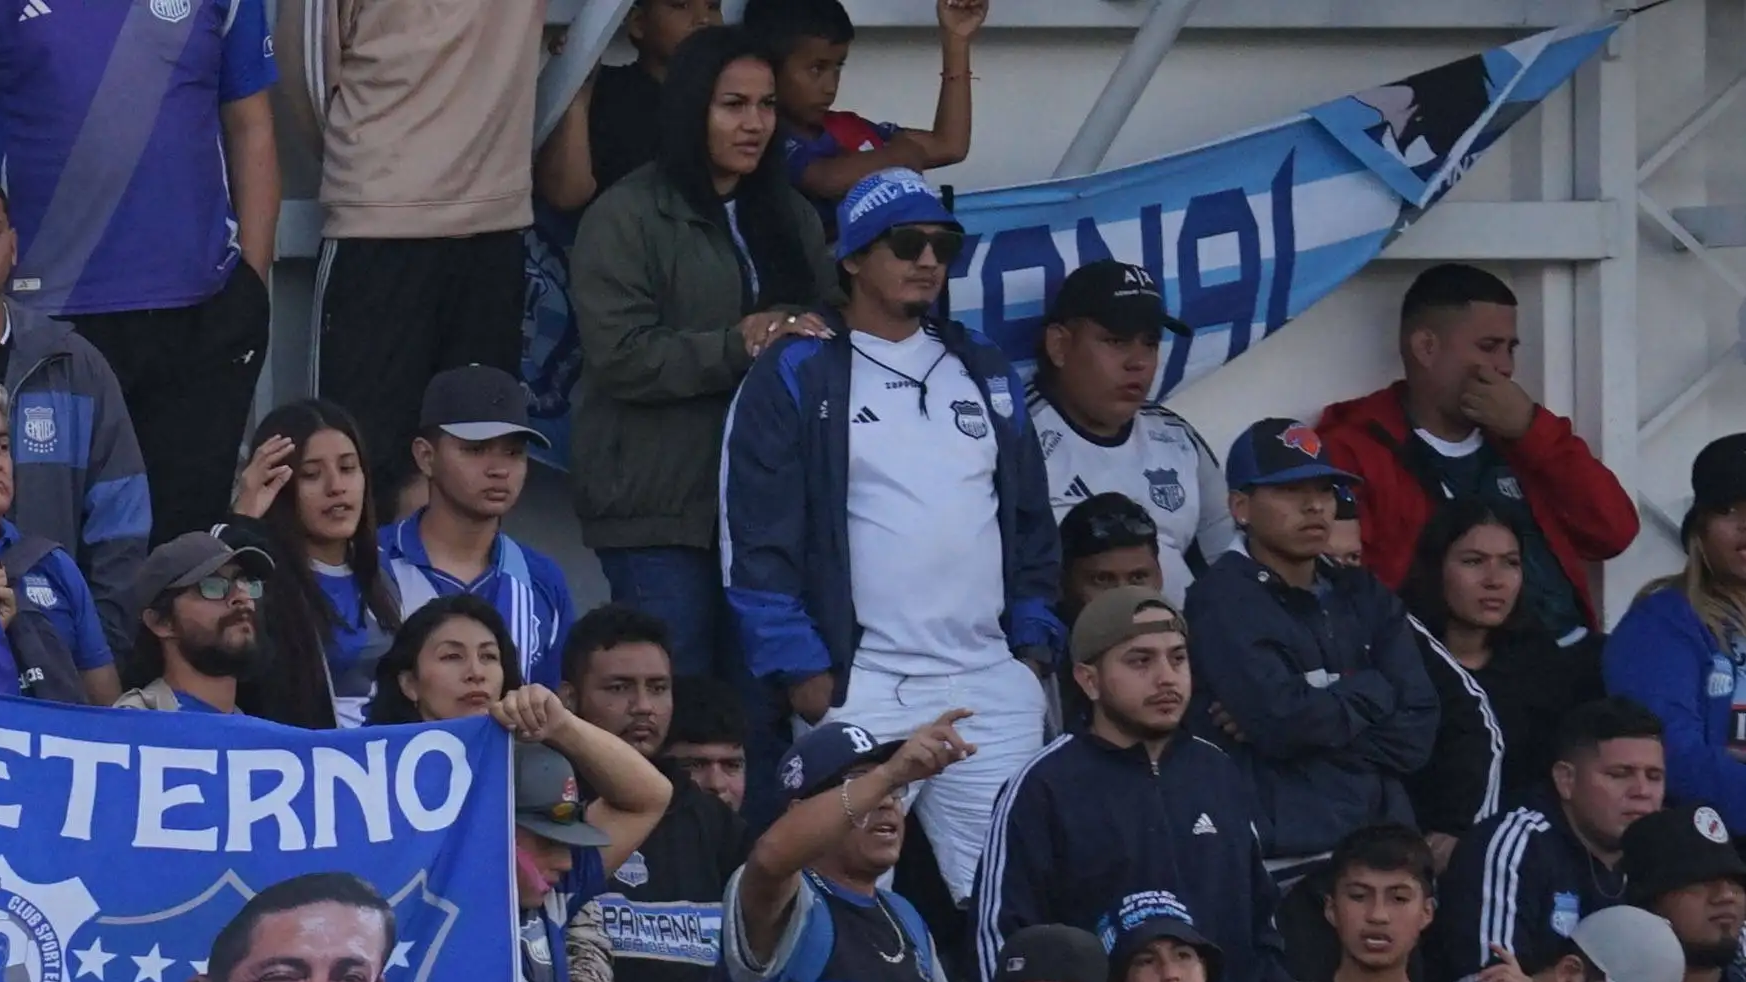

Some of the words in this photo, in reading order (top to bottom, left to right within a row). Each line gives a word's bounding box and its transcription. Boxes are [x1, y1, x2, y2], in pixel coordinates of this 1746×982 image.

[841, 727, 874, 754] B
[9, 894, 42, 928] CLUB
[34, 922, 62, 970] SPORT
[602, 905, 713, 945] PANTANAL
